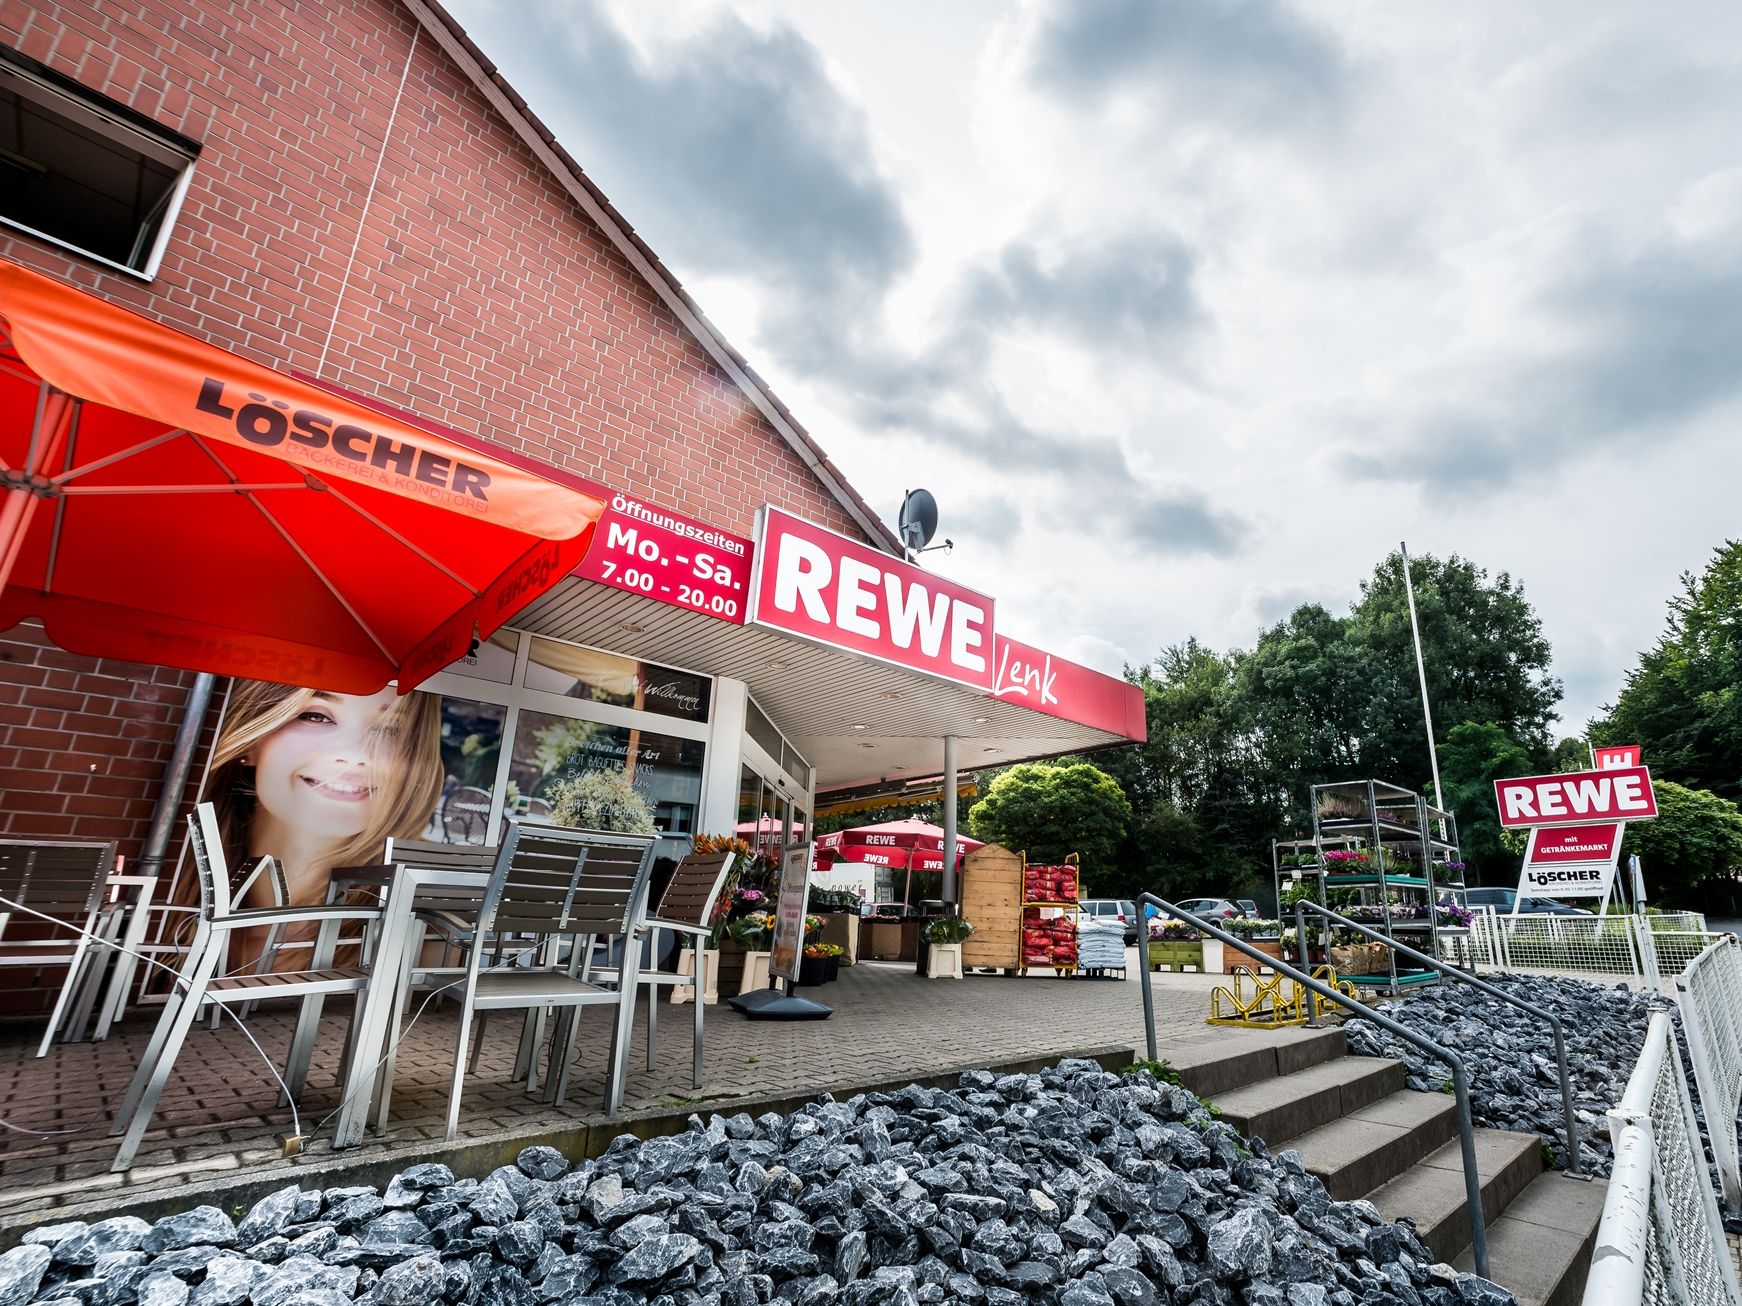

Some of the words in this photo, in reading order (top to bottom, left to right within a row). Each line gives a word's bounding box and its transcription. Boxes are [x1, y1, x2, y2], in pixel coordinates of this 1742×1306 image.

[196, 376, 492, 502] LÖSCHER
[395, 477, 489, 514] KONDITOREI
[611, 493, 745, 556] Öffnungszeiten
[601, 560, 654, 592] 7.00
[677, 584, 738, 617] 20.00
[773, 532, 986, 673] REWE
[994, 643, 1059, 705] Lenk
[1503, 775, 1649, 819] REWE
[825, 836, 838, 847] REWE
[866, 834, 896, 846] REWE
[937, 840, 966, 854] RE
[1540, 843, 1608, 854] GETRÄNKEMARKT
[1528, 870, 1600, 886] LÖSCHER
